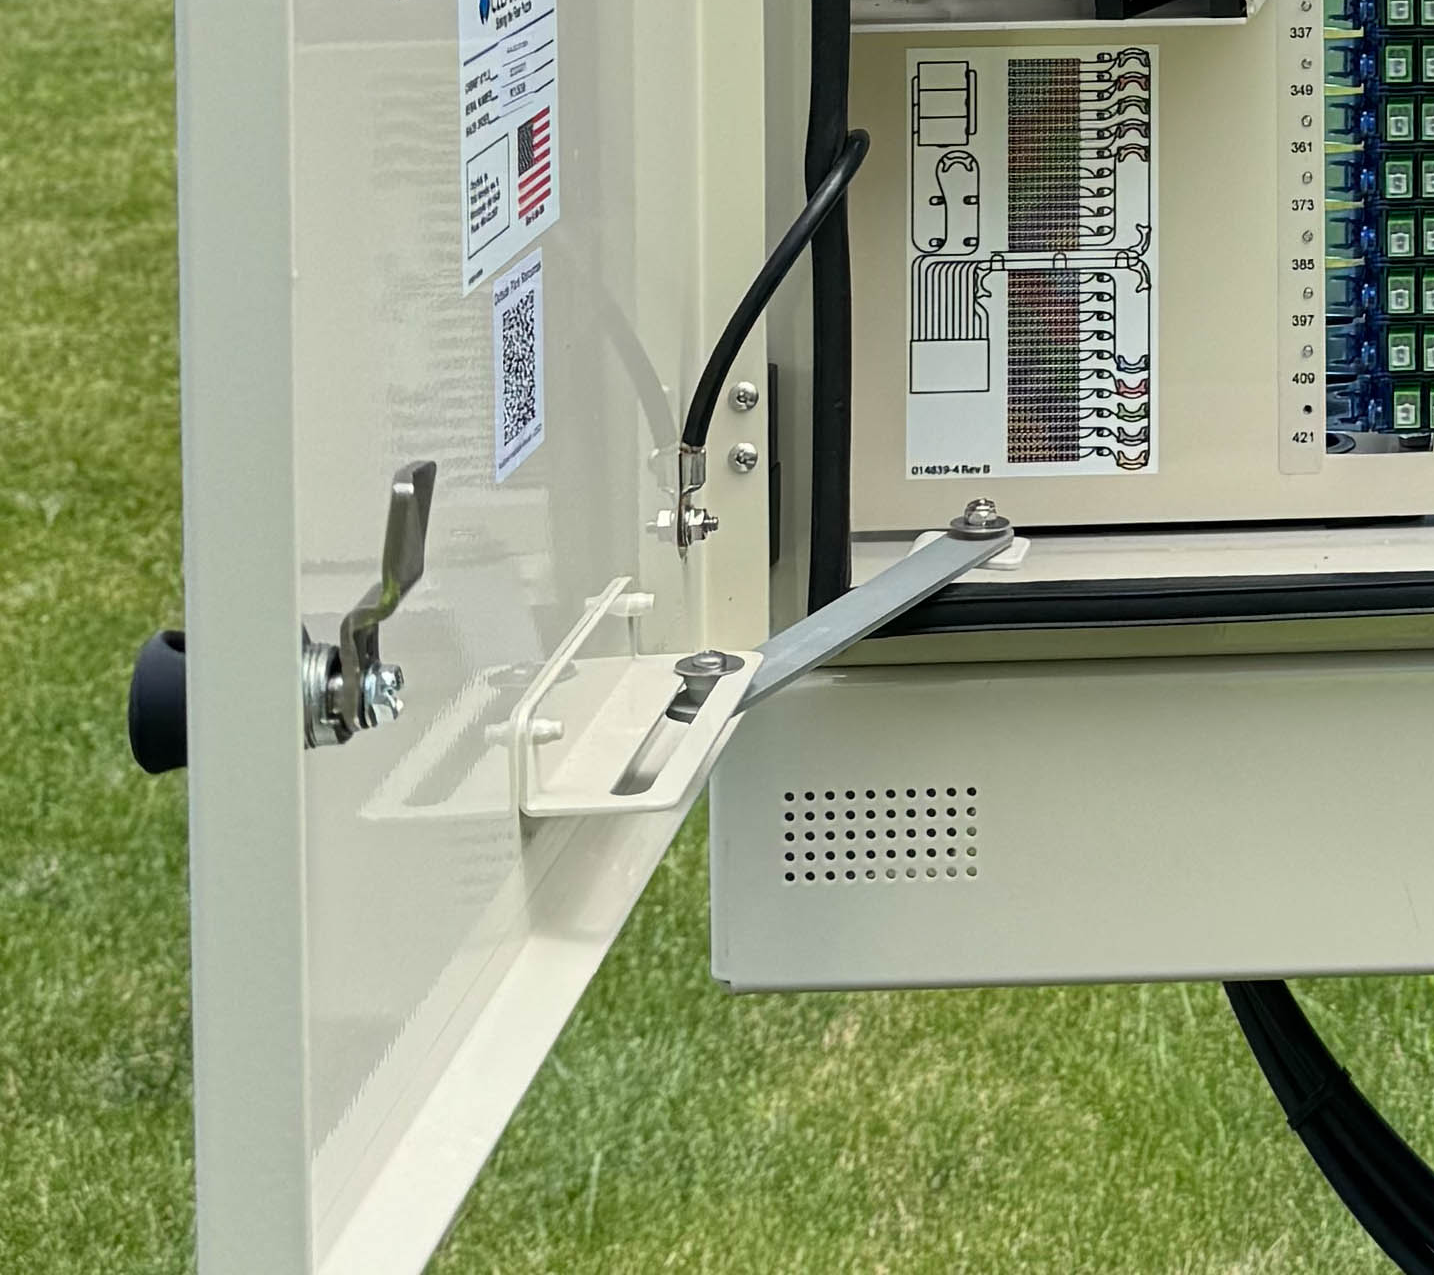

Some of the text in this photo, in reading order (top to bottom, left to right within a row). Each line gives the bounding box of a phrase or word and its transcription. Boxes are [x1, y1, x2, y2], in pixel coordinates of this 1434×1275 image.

[1289, 26, 1313, 39] 337
[1291, 198, 1315, 212] 373
[1291, 258, 1315, 271] 385
[1292, 314, 1315, 327] 397
[1291, 372, 1316, 385] 409
[1292, 431, 1314, 444] 421
[911, 464, 959, 475] 014839-4
[961, 464, 980, 475] Rev
